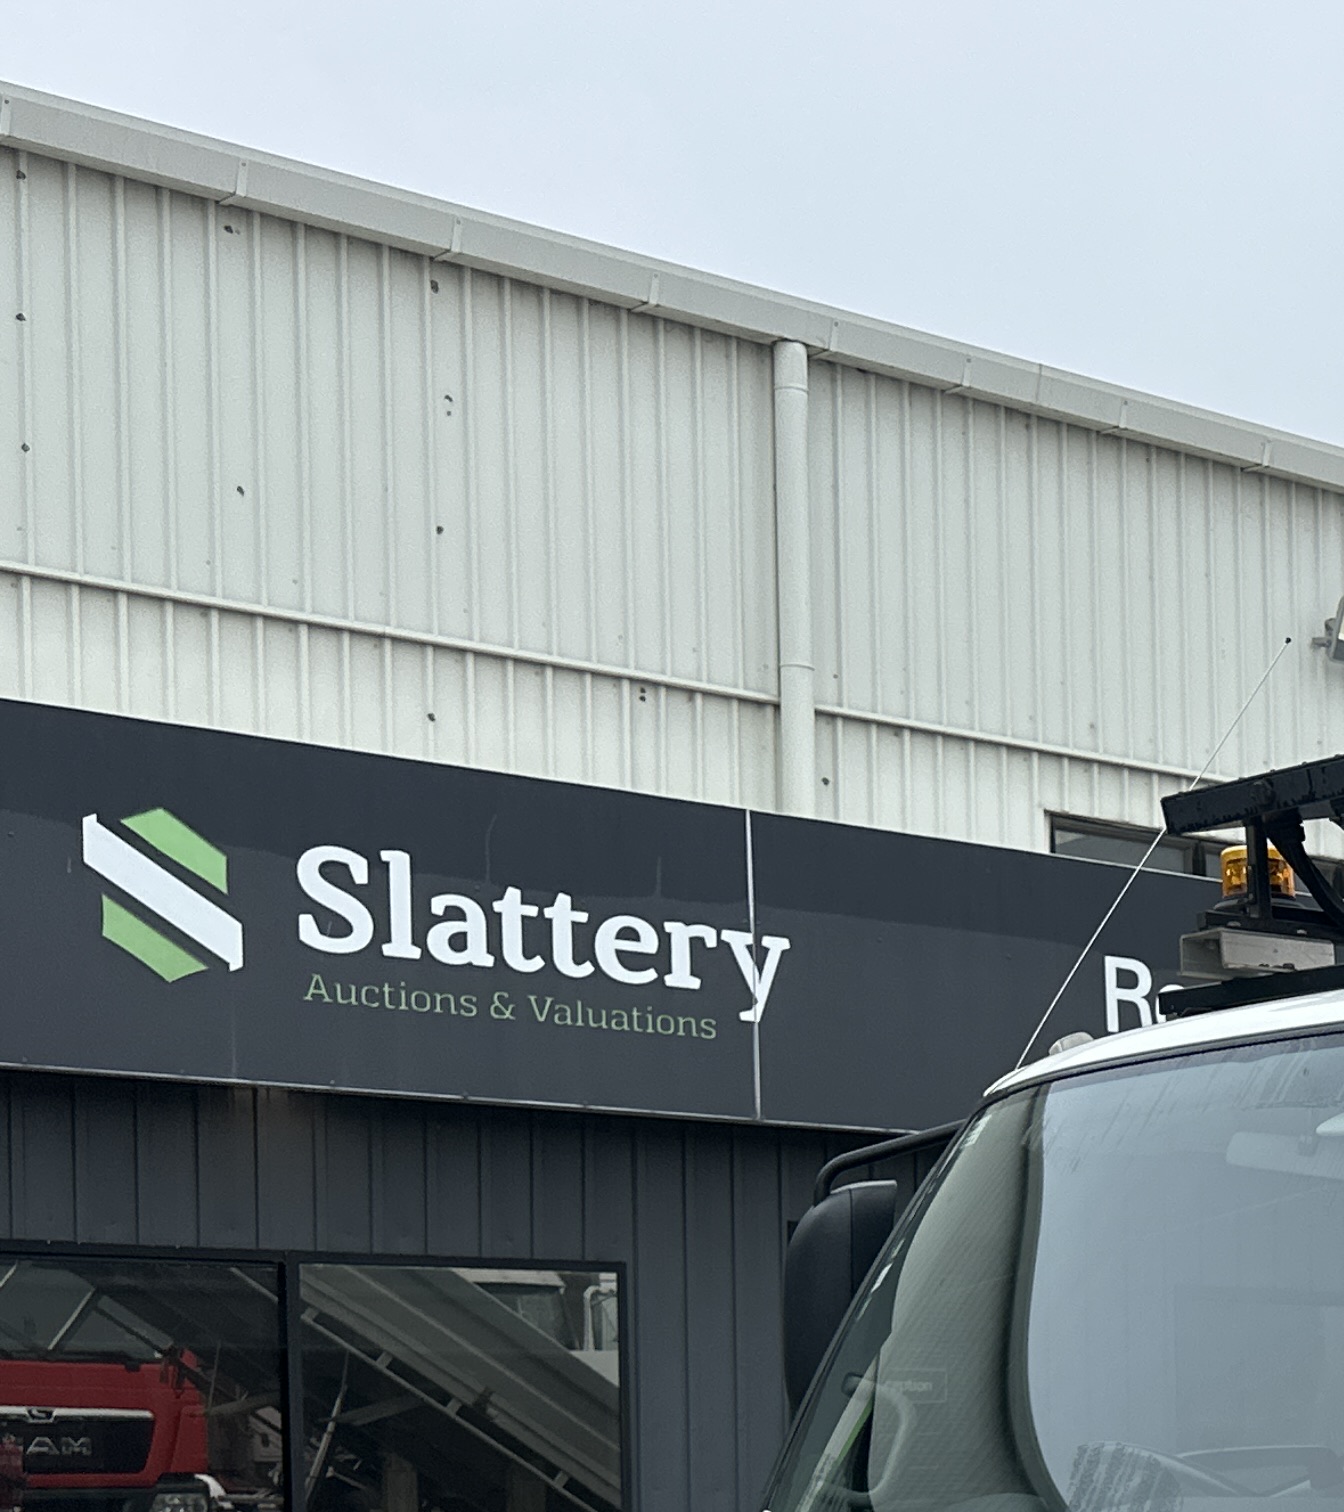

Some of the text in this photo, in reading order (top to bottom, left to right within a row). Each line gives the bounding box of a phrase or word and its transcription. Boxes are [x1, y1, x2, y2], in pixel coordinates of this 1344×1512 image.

[297, 845, 790, 1022] Slattery
[303, 974, 718, 1040] Auctions & Valuations
